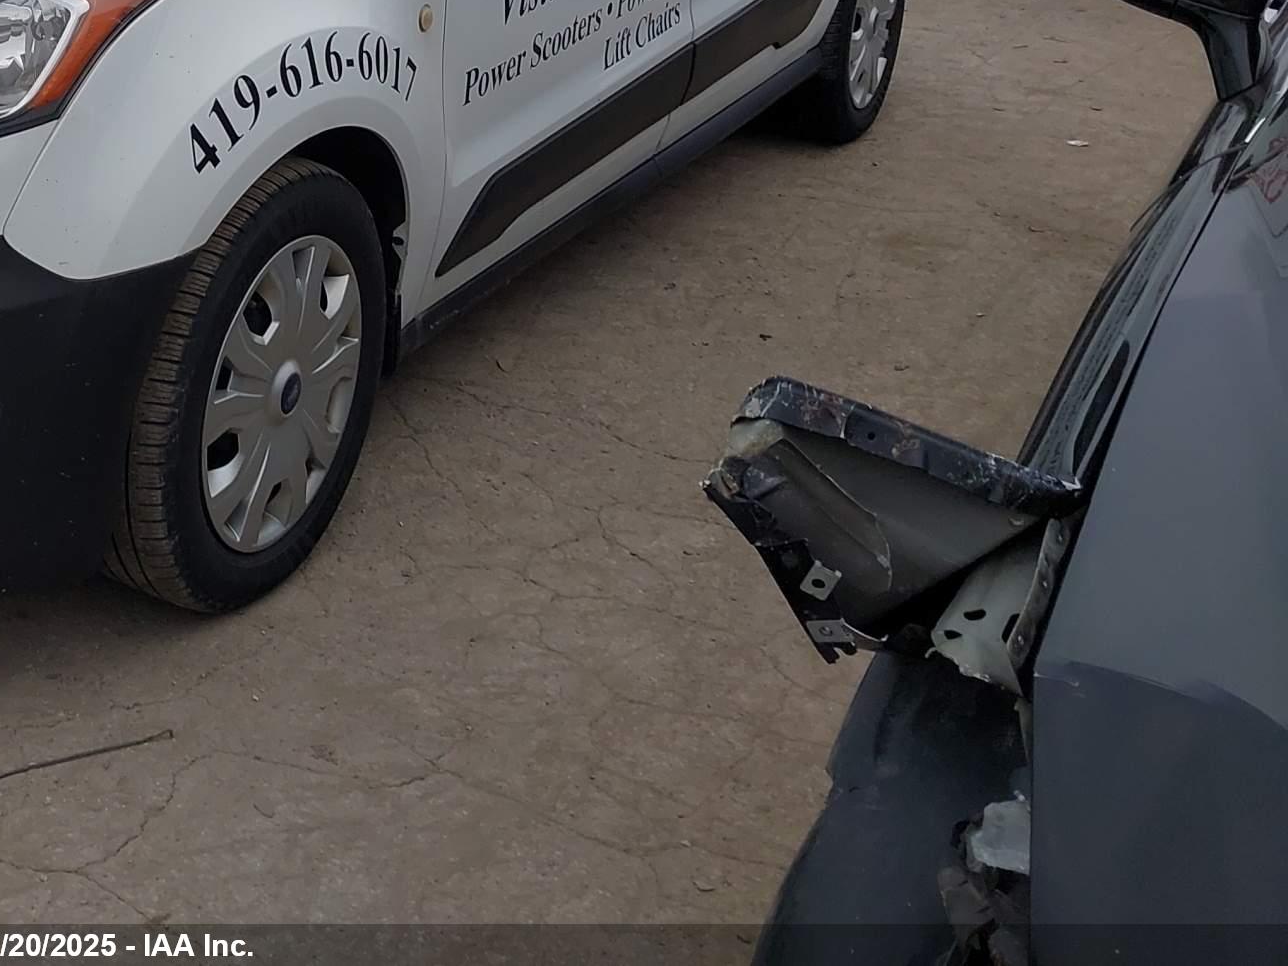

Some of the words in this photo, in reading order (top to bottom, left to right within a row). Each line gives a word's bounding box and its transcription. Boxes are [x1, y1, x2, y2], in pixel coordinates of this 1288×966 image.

[463, 48, 527, 106] Power
[530, 8, 603, 68] Scooters
[603, 28, 632, 71] Lift
[635, 0, 681, 47] Chairs
[189, 31, 419, 175] 419-616-6017
